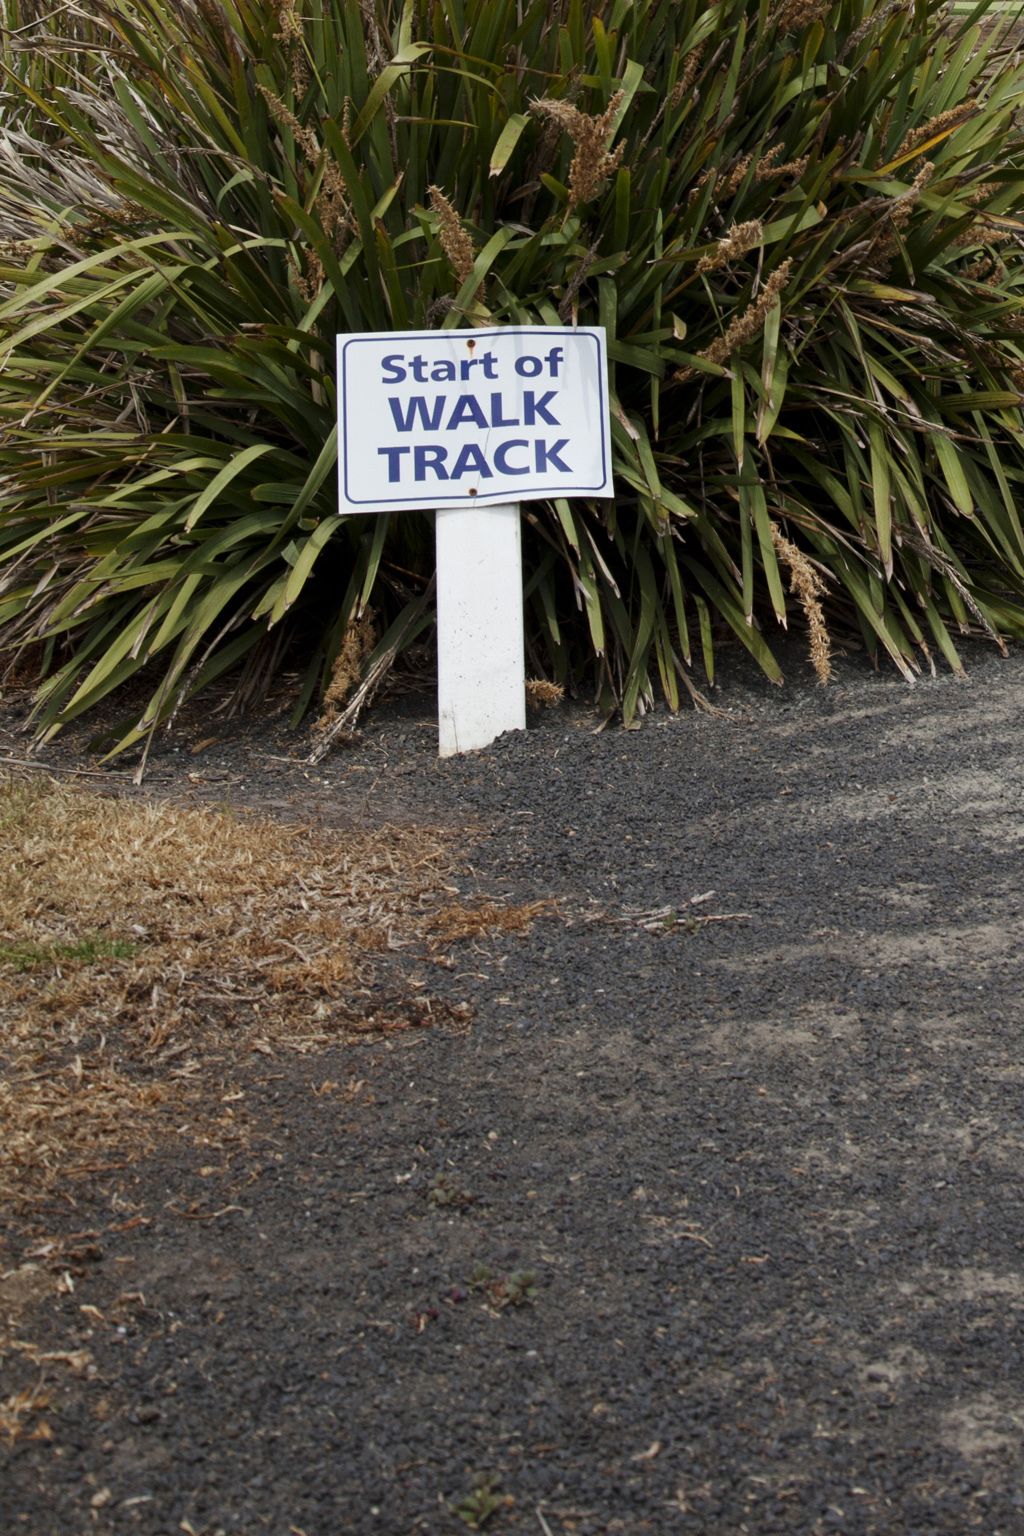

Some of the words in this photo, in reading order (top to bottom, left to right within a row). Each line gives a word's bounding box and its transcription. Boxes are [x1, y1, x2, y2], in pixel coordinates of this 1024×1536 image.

[381, 352, 498, 383] Start
[515, 347, 564, 378] of
[388, 391, 561, 432] WALK
[378, 439, 573, 482] TRACK
